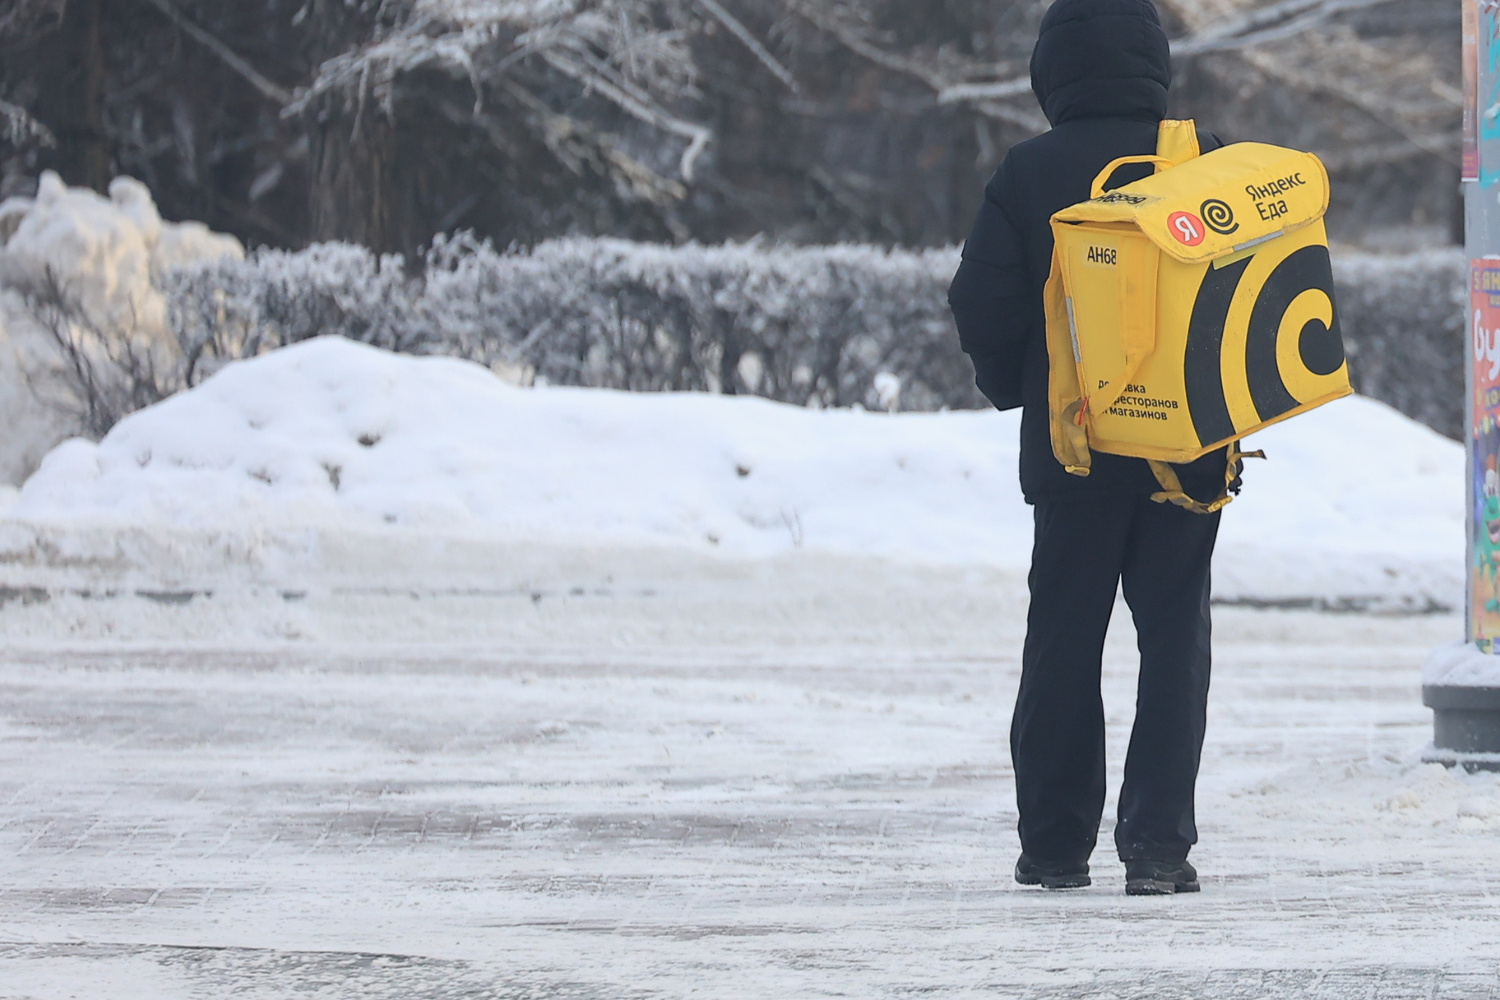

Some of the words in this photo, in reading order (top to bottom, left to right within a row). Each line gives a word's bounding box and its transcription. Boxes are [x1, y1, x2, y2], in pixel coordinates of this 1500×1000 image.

[1244, 172, 1306, 202] Яндекс
[1255, 199, 1289, 222] Еда
[1174, 215, 1199, 242] Я
[1109, 407, 1168, 421] магазинов
